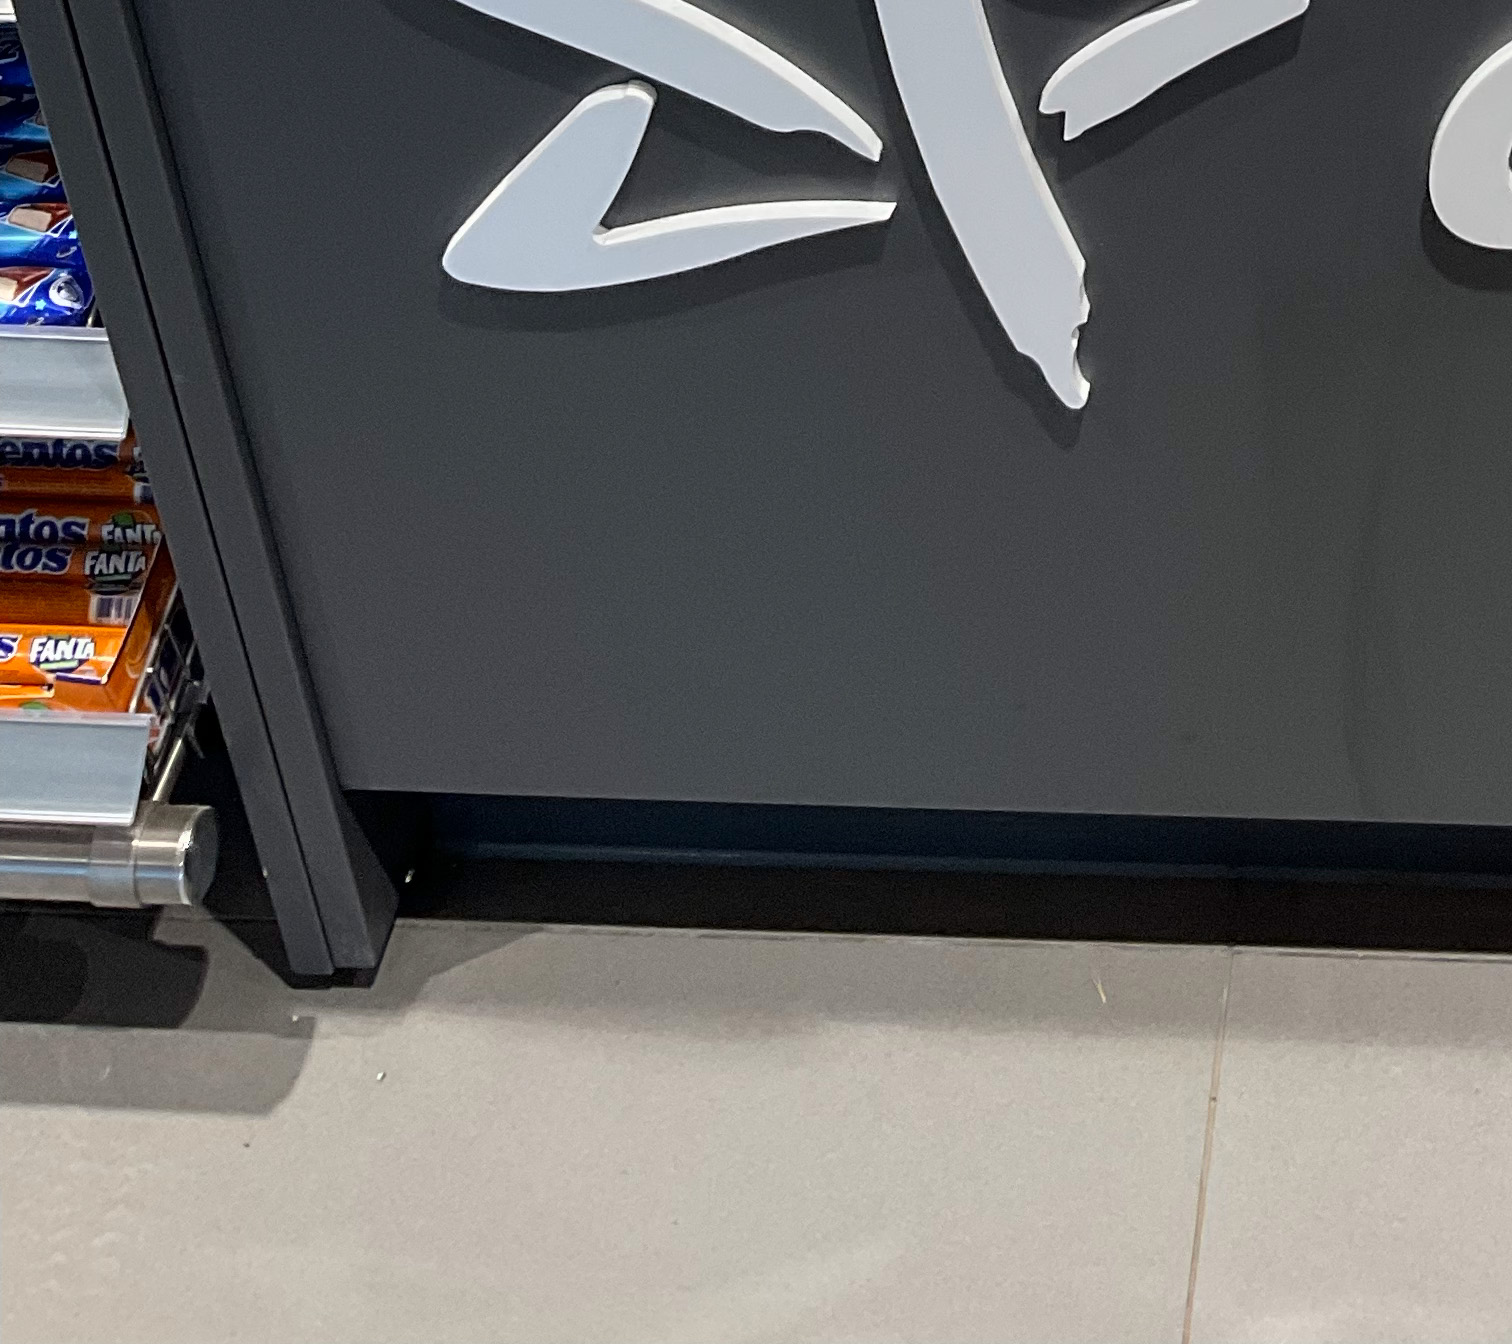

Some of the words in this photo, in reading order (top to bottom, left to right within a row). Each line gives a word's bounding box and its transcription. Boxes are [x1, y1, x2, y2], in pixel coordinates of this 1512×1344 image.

[0, 438, 119, 468] entos
[84, 550, 147, 577] FANTA
[29, 636, 96, 663] FANTA
